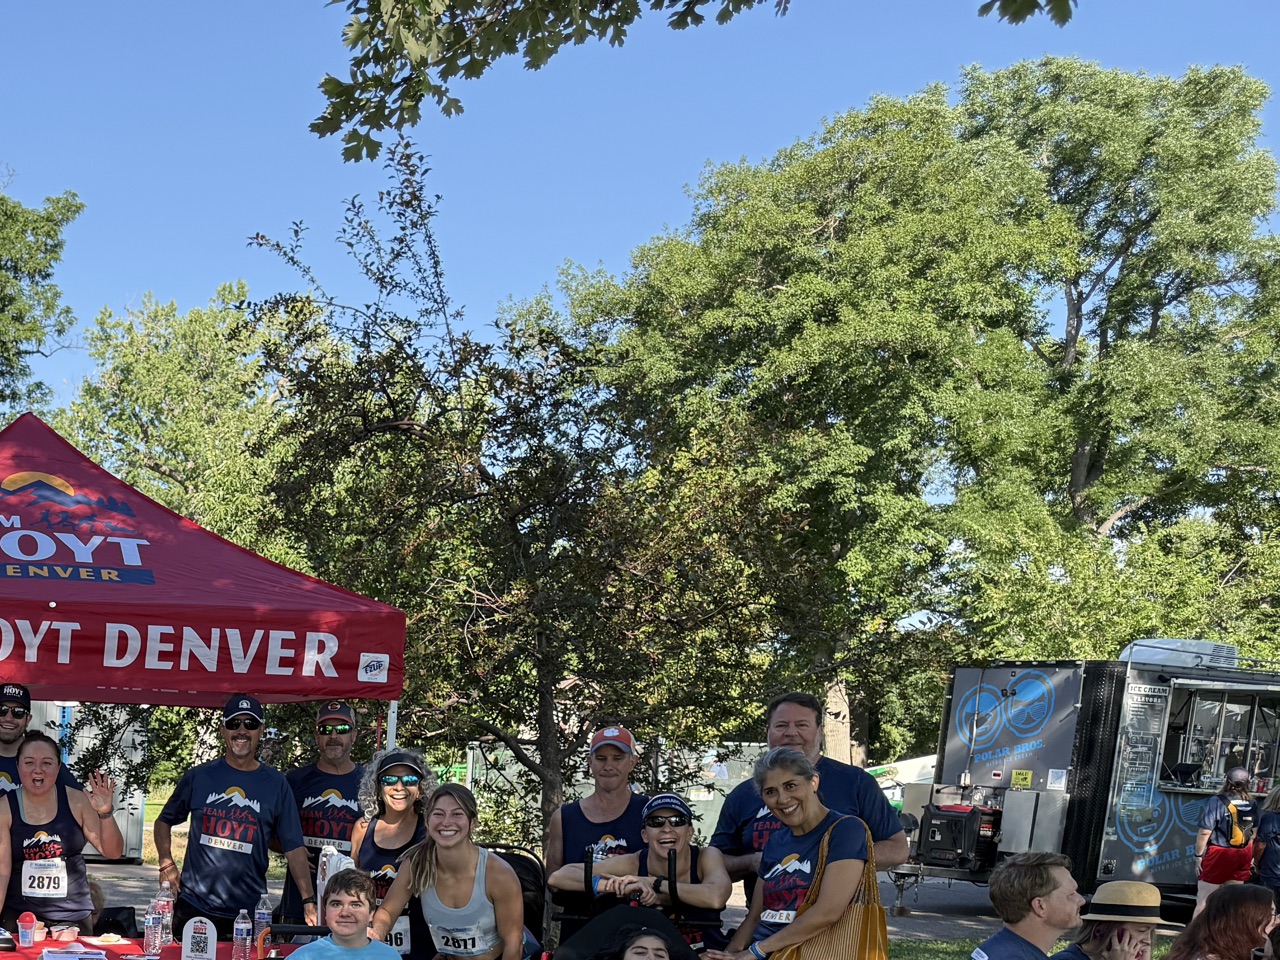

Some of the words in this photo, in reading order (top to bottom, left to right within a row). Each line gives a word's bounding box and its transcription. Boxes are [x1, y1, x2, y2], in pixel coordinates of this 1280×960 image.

[103, 622, 339, 678] DENVER
[974, 746, 1011, 763] POLAR
[203, 806, 226, 818] TEAM
[201, 815, 258, 842] HOYT
[753, 821, 781, 830] TEAM
[207, 837, 244, 850] DENVER
[308, 838, 343, 849] DENVER
[1136, 849, 1180, 871] POLAR
[28, 875, 60, 890] 2879
[441, 935, 476, 949] 2877
